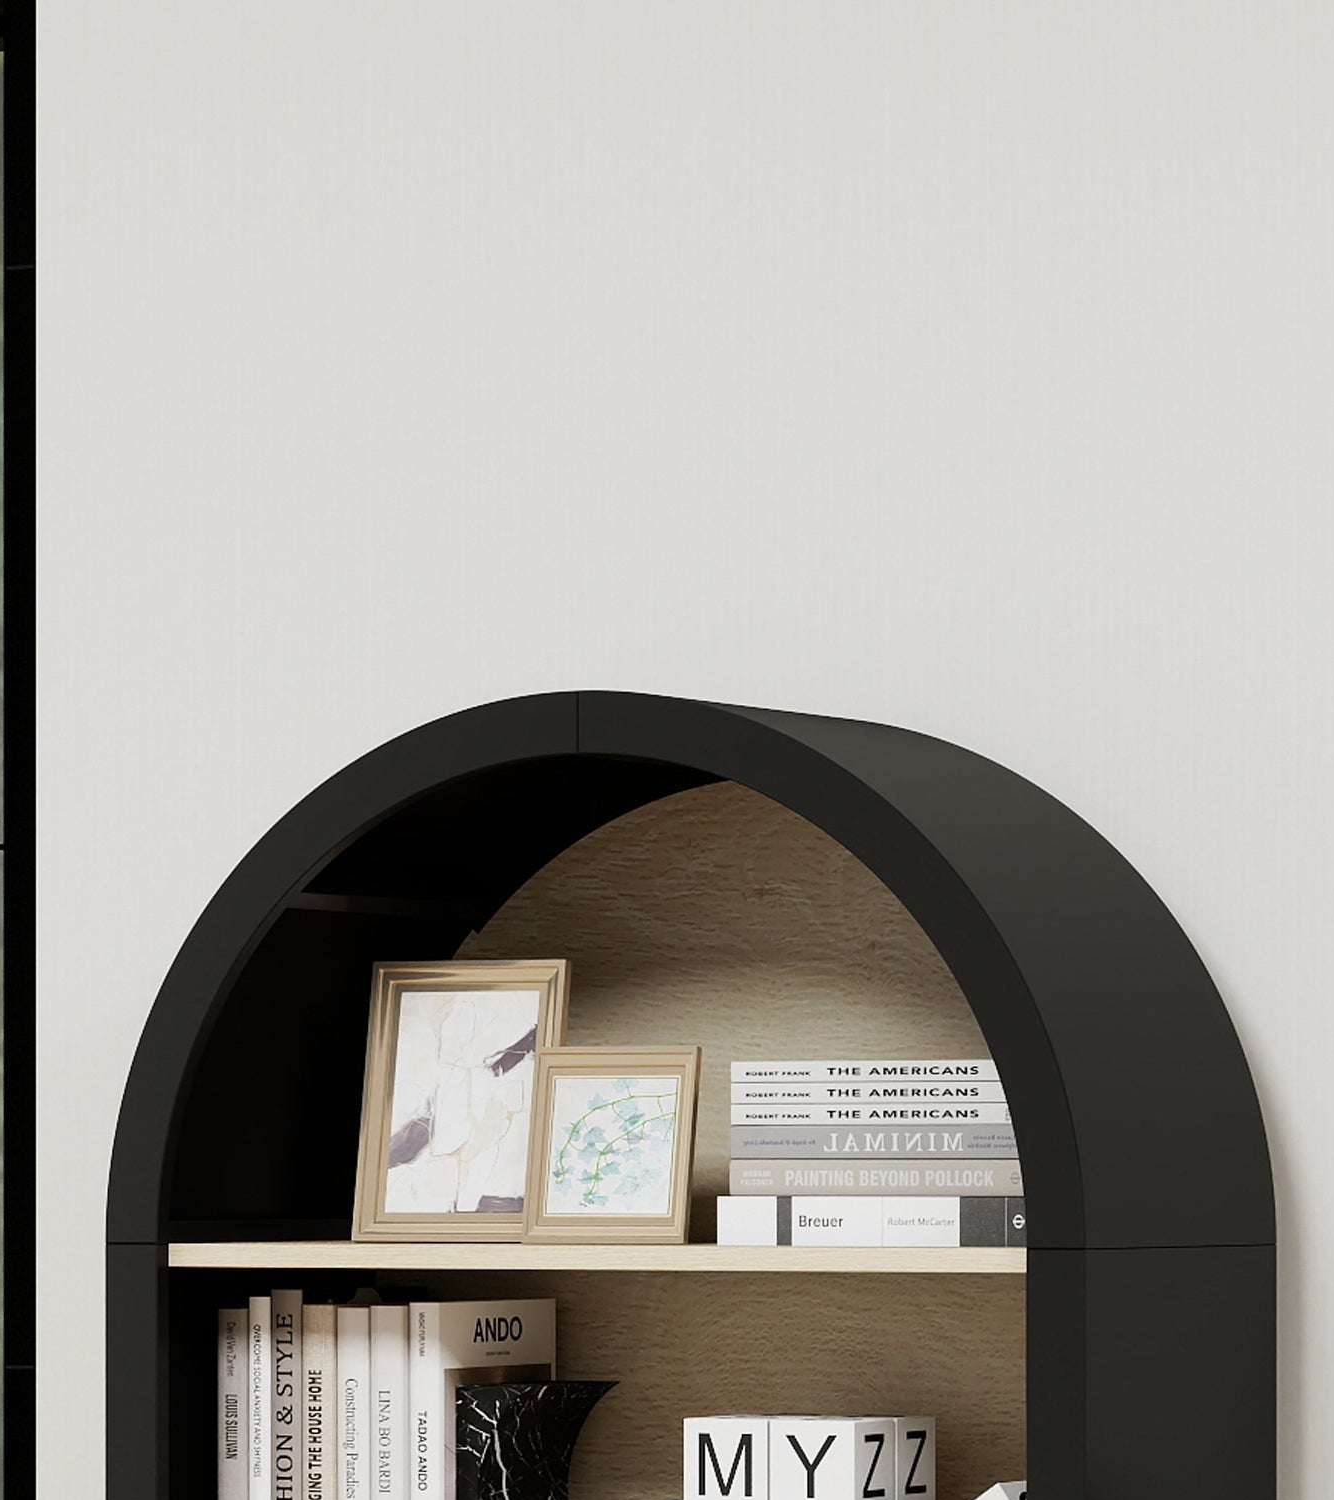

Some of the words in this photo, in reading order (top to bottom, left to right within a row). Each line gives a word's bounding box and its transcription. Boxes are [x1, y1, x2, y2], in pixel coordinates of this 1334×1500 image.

[826, 1067, 861, 1076] THE
[869, 1066, 979, 1076] AMERICANS
[826, 1089, 861, 1097] THE
[869, 1088, 979, 1097] AMERICANS
[826, 1110, 861, 1119] THE
[869, 1109, 979, 1119] AMERICANS
[785, 1169, 854, 1187] PAINTING
[859, 1169, 919, 1187] BEYOND
[925, 1169, 994, 1188] POLLOCK
[798, 1215, 843, 1228] Breuer
[887, 1217, 915, 1226] Robert
[917, 1217, 955, 1227] McCarter
[473, 1316, 523, 1343] ANDO
[253, 1324, 262, 1365] OVERCOME
[276, 1313, 293, 1397] STYLE
[253, 1367, 262, 1393] SOCIAL
[308, 1369, 322, 1402] HOME
[225, 1394, 238, 1418] LOUIS
[253, 1395, 262, 1427] ANXIETY
[276, 1404, 293, 1425] &
[342, 1378, 359, 1450] Constructing
[379, 1390, 391, 1423] LINA
[253, 1428, 262, 1445] AND
[308, 1406, 322, 1444] HOUSE
[379, 1427, 391, 1446] BO
[417, 1411, 428, 1453] TADAO
[225, 1419, 238, 1459] SULLIVAN
[308, 1447, 322, 1469] THE
[378, 1450, 391, 1493] BARDI
[698, 1432, 837, 1498] MY
[417, 1456, 428, 1491] ANDO
